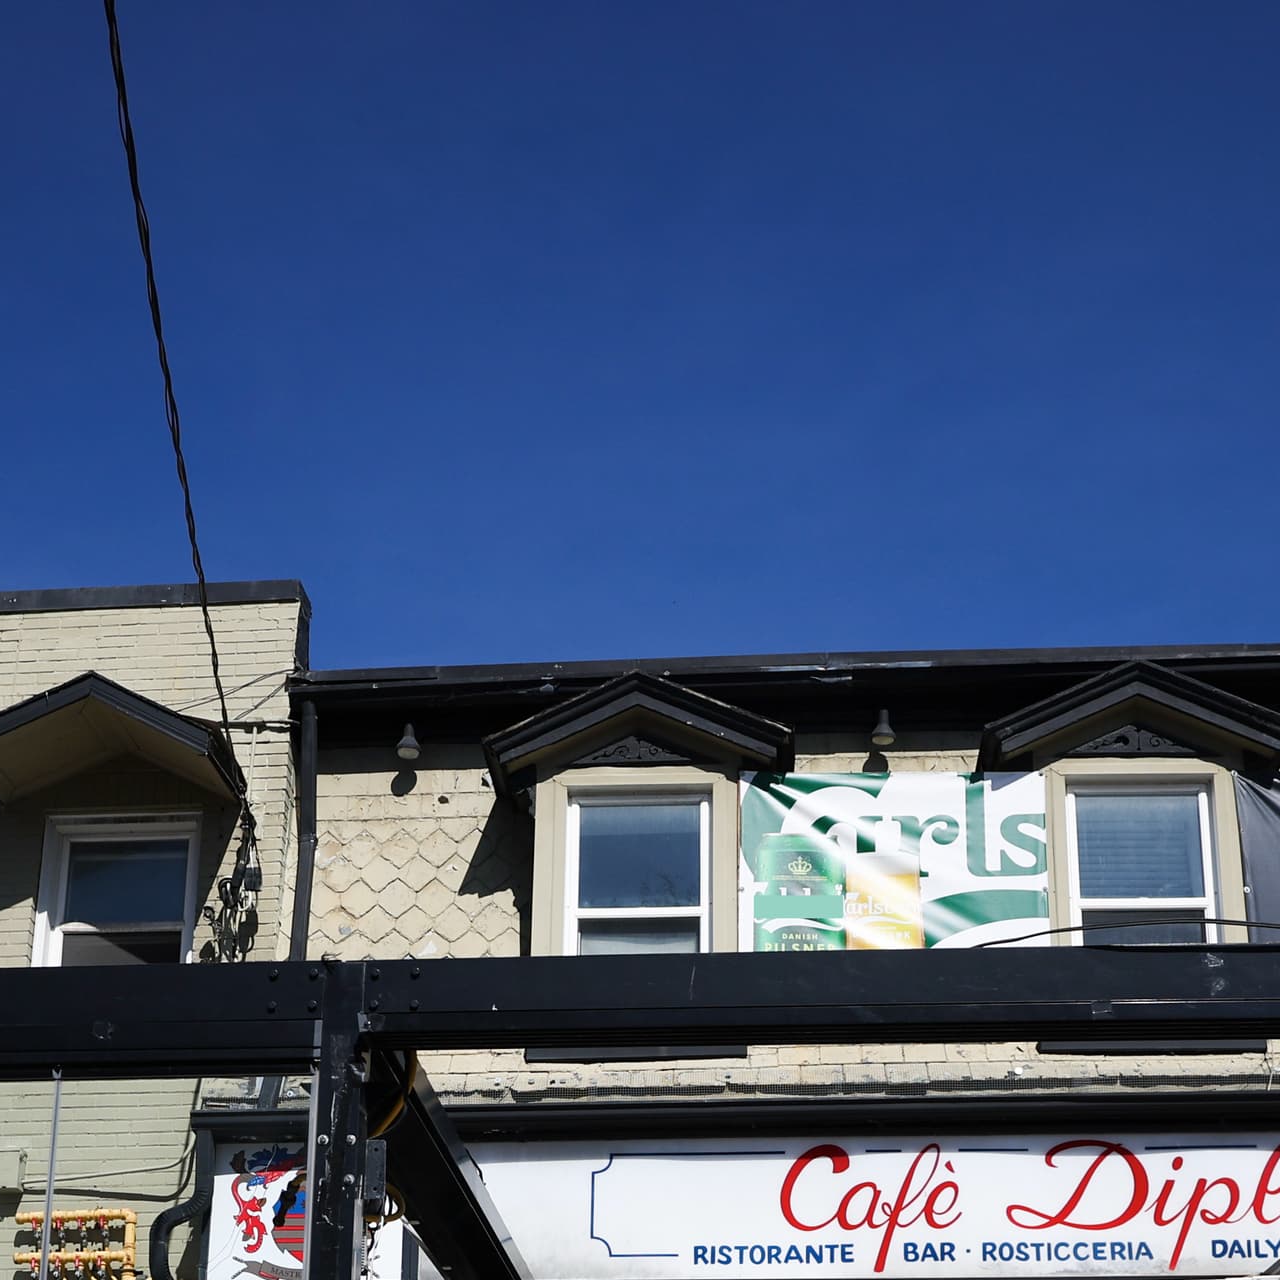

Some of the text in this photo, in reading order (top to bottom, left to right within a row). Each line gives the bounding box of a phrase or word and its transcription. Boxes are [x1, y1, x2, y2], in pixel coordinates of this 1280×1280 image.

[782, 933, 818, 941] DANISH
[693, 1243, 855, 1265] RISTORANTE
[903, 1242, 956, 1262] BAR
[981, 1241, 1154, 1263] ROSTICCERIA
